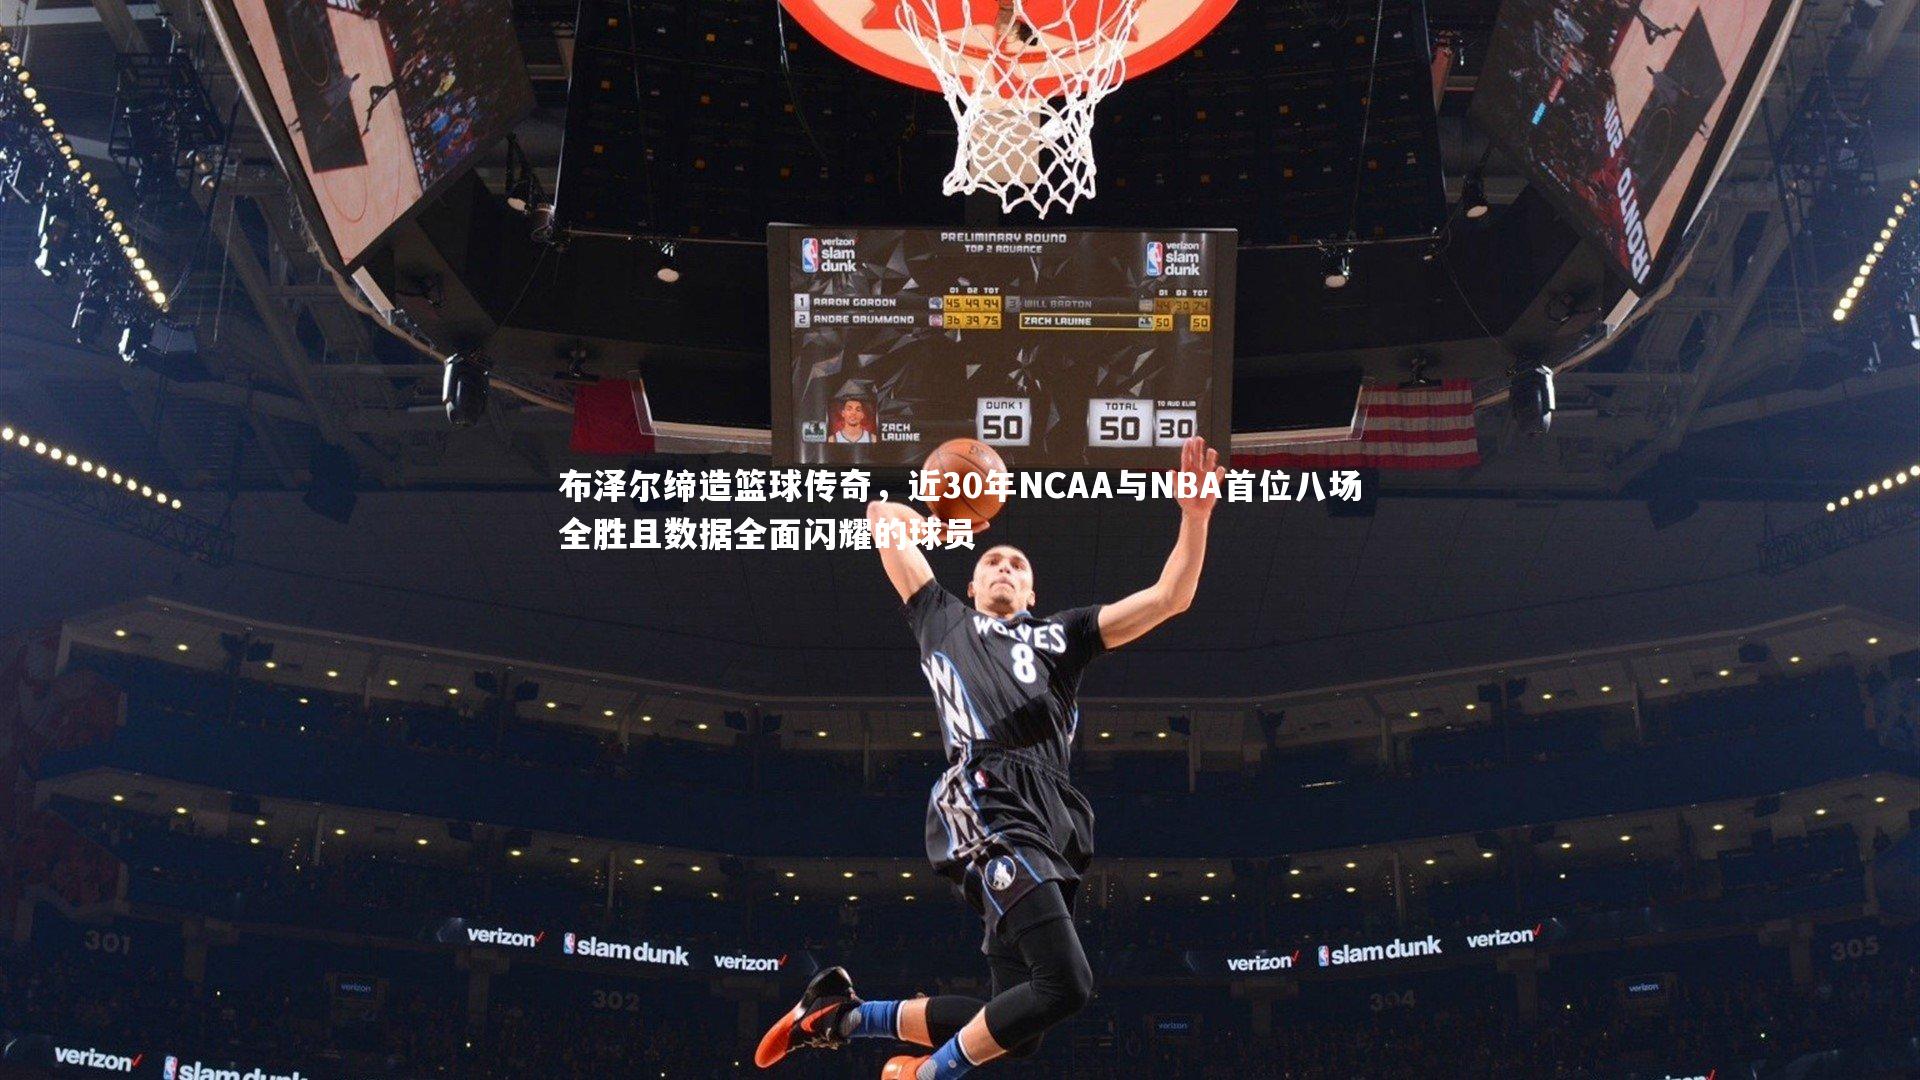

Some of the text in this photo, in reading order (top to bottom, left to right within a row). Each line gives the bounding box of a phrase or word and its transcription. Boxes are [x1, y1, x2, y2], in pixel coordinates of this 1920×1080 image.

[821, 237, 855, 246] verizon
[941, 232, 1067, 243] PRELIMINARY ROUND
[965, 244, 984, 253] TOP
[987, 245, 993, 253] 2
[1165, 241, 1200, 250] verizon
[821, 246, 856, 259] slam
[1165, 250, 1200, 263] slam
[821, 259, 857, 272] dunk
[1165, 263, 1200, 276] dunk
[813, 298, 850, 307] AARON
[853, 298, 897, 307] GORDON
[946, 299, 960, 308] 45
[965, 299, 979, 308] 49
[984, 300, 998, 308] 94
[813, 315, 849, 323] ANDRE
[853, 315, 914, 324] DRUMMOND
[965, 316, 979, 325] 39
[984, 316, 998, 325] 75
[1024, 316, 1052, 325] ZACH
[1156, 318, 1170, 327] 50
[1193, 318, 1207, 327] 50
[985, 401, 1015, 409] DUNK
[1105, 402, 1138, 410] TOTAL
[881, 423, 911, 432] ZACH
[983, 415, 1023, 439] 50
[1100, 416, 1140, 440] 50
[1159, 418, 1193, 438] 30
[973, 616, 1067, 653] WOLVES
[1011, 642, 1037, 683] 8
[467, 927, 536, 948] verizon
[1466, 929, 1534, 948] verizon
[713, 954, 780, 971] verizon
[1226, 955, 1292, 971] verizon
[54, 1046, 132, 1072] verizon
